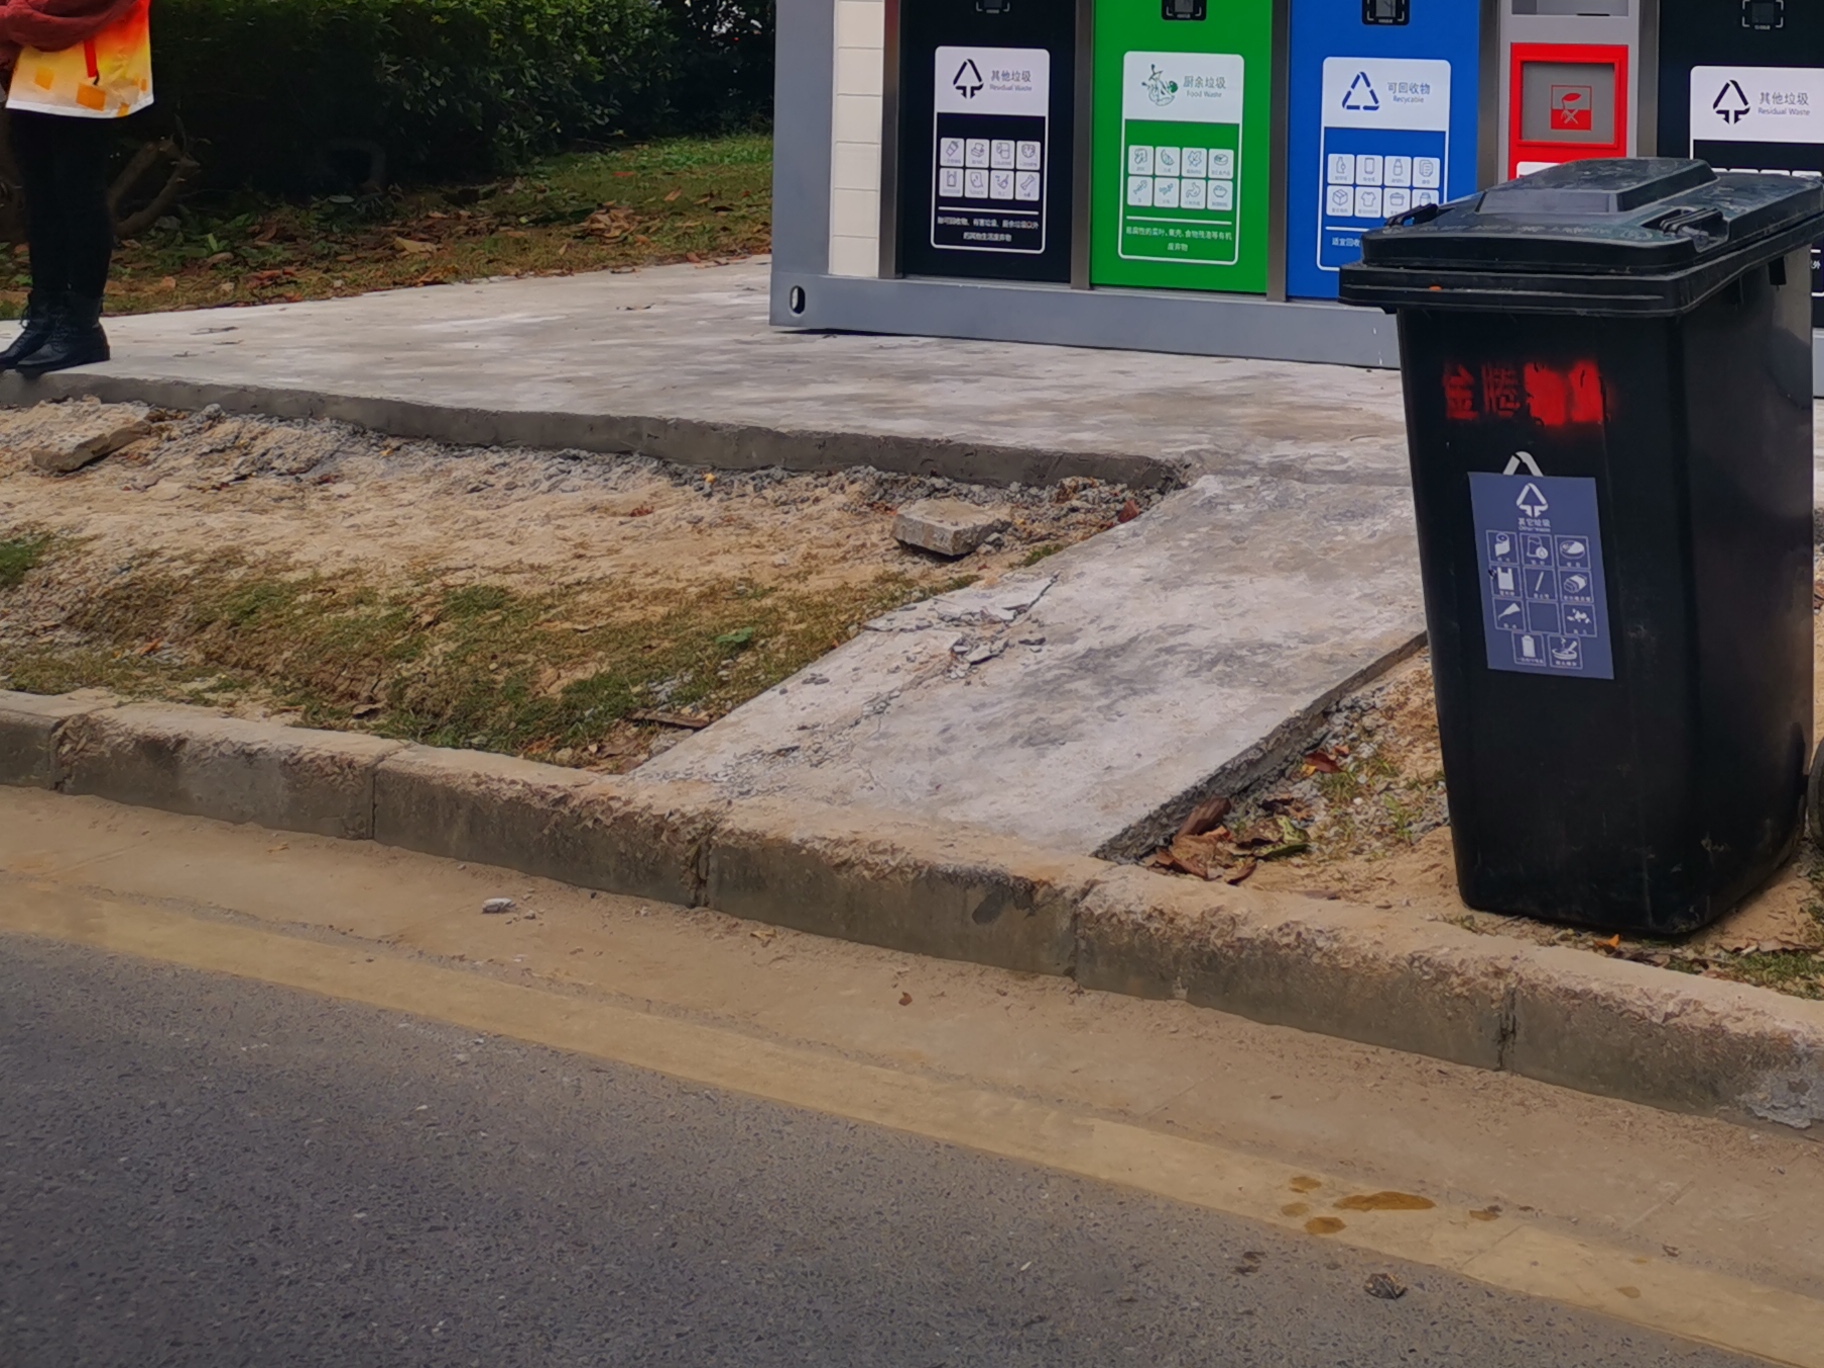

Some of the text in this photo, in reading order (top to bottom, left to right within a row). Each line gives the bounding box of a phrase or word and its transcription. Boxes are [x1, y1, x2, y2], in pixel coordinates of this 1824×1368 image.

[991, 70, 1031, 82] 其他垃圾
[1183, 75, 1226, 89] 厨余垃圾
[1387, 82, 1430, 95] 可回收物
[1759, 92, 1809, 106] 其他垃圾
